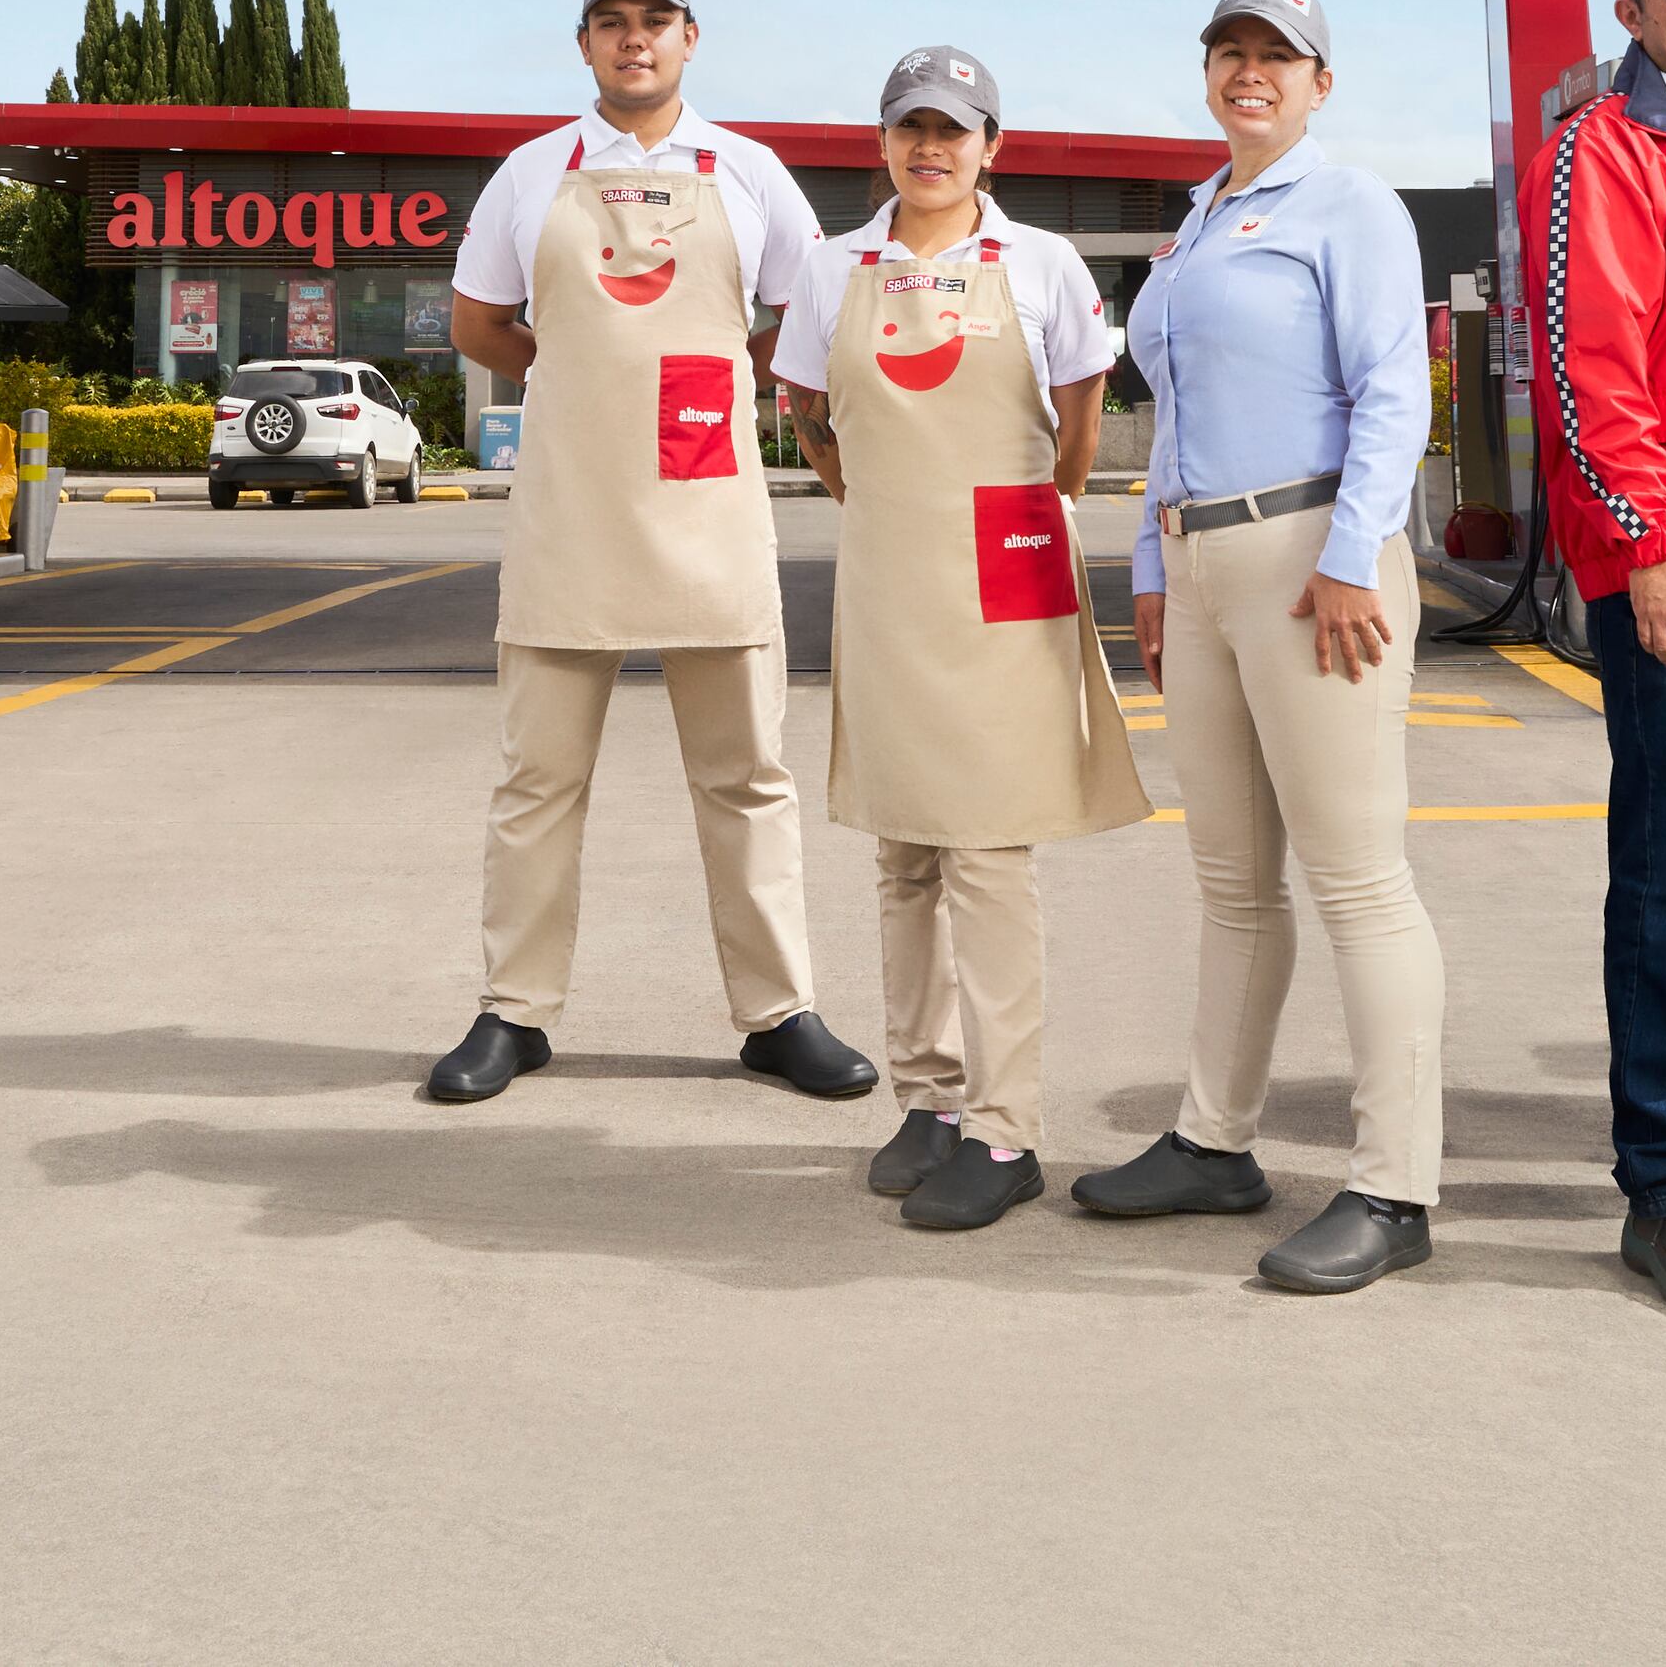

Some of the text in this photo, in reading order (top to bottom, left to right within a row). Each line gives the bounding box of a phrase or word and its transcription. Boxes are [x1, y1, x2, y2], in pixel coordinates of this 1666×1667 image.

[602, 190, 644, 202] SBARRO
[106, 171, 449, 268] altoque
[885, 276, 933, 292] SBARRO
[967, 322, 991, 331] Angie
[678, 406, 724, 427] altoque
[1004, 533, 1052, 549] altoque
